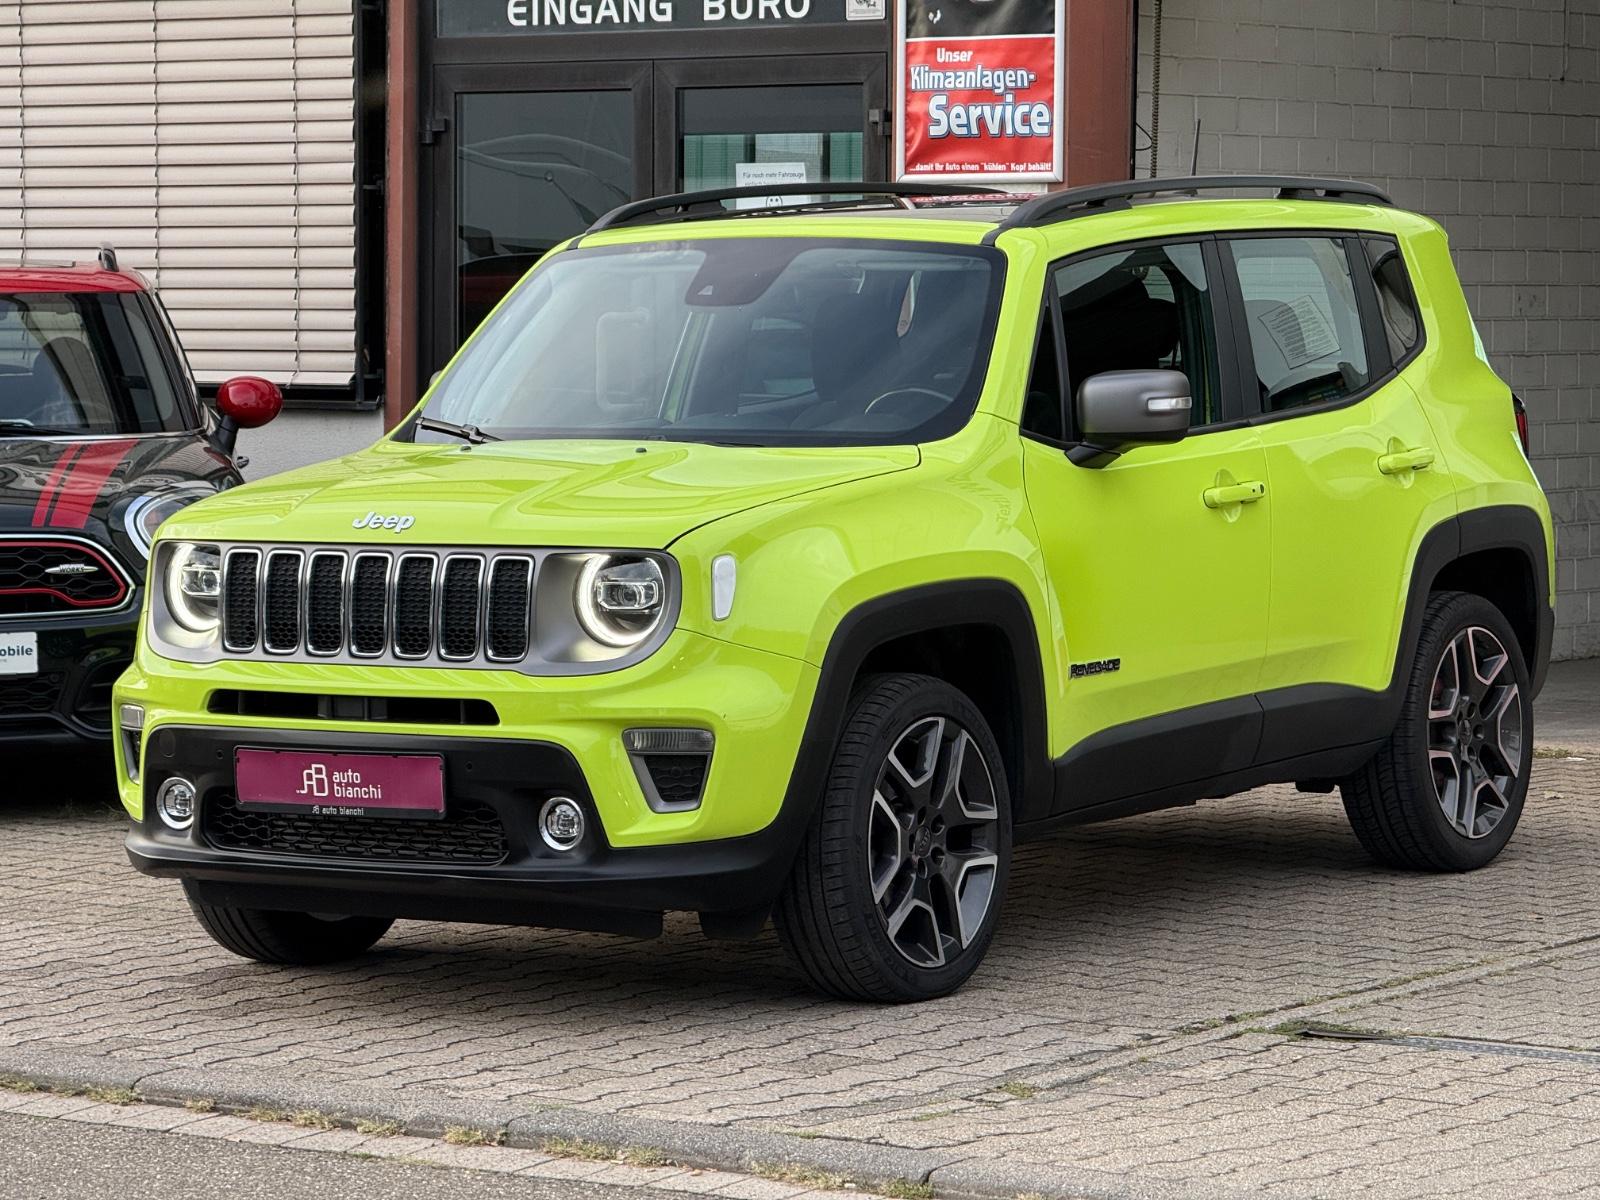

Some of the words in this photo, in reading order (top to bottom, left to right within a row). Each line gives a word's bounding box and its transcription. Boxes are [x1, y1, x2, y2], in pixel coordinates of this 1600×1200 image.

[507, 0, 673, 26] EINGANG
[936, 48, 973, 63] Unser
[910, 64, 1036, 93] Klimaanlagen-
[928, 94, 1052, 138] Service
[945, 162, 960, 171] Auto
[961, 162, 979, 170] einen
[1010, 162, 1027, 172] Kopf
[352, 511, 416, 534] Jeep
[1069, 658, 1121, 680] RENEGADE
[332, 769, 361, 784] auto
[333, 784, 382, 799] bianchi
[322, 806, 337, 815] auto
[339, 807, 364, 816] bianchi
